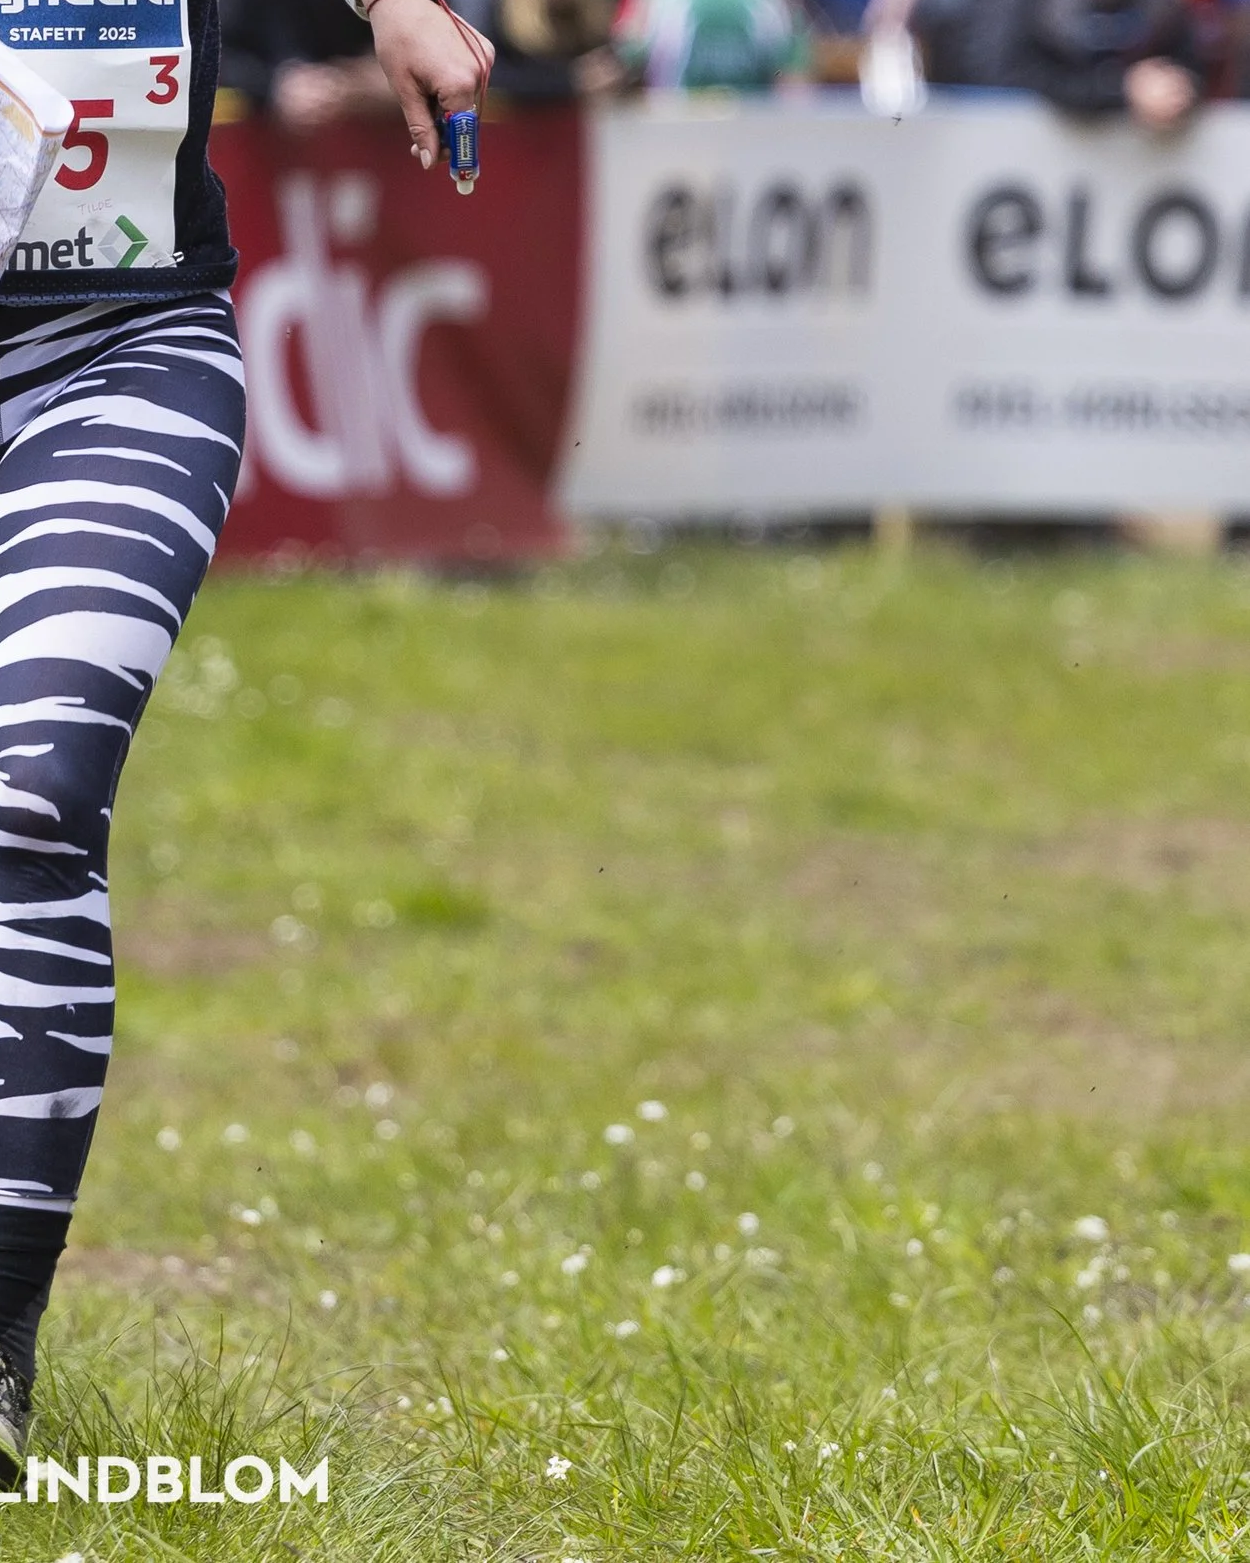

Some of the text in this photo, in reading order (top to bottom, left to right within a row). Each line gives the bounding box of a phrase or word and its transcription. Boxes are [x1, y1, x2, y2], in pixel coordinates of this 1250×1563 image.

[9, 27, 86, 42] STAFETT
[99, 26, 137, 41] 2025
[146, 55, 180, 105] 3
[54, 99, 114, 191] 5
[77, 198, 114, 216] TILDE
